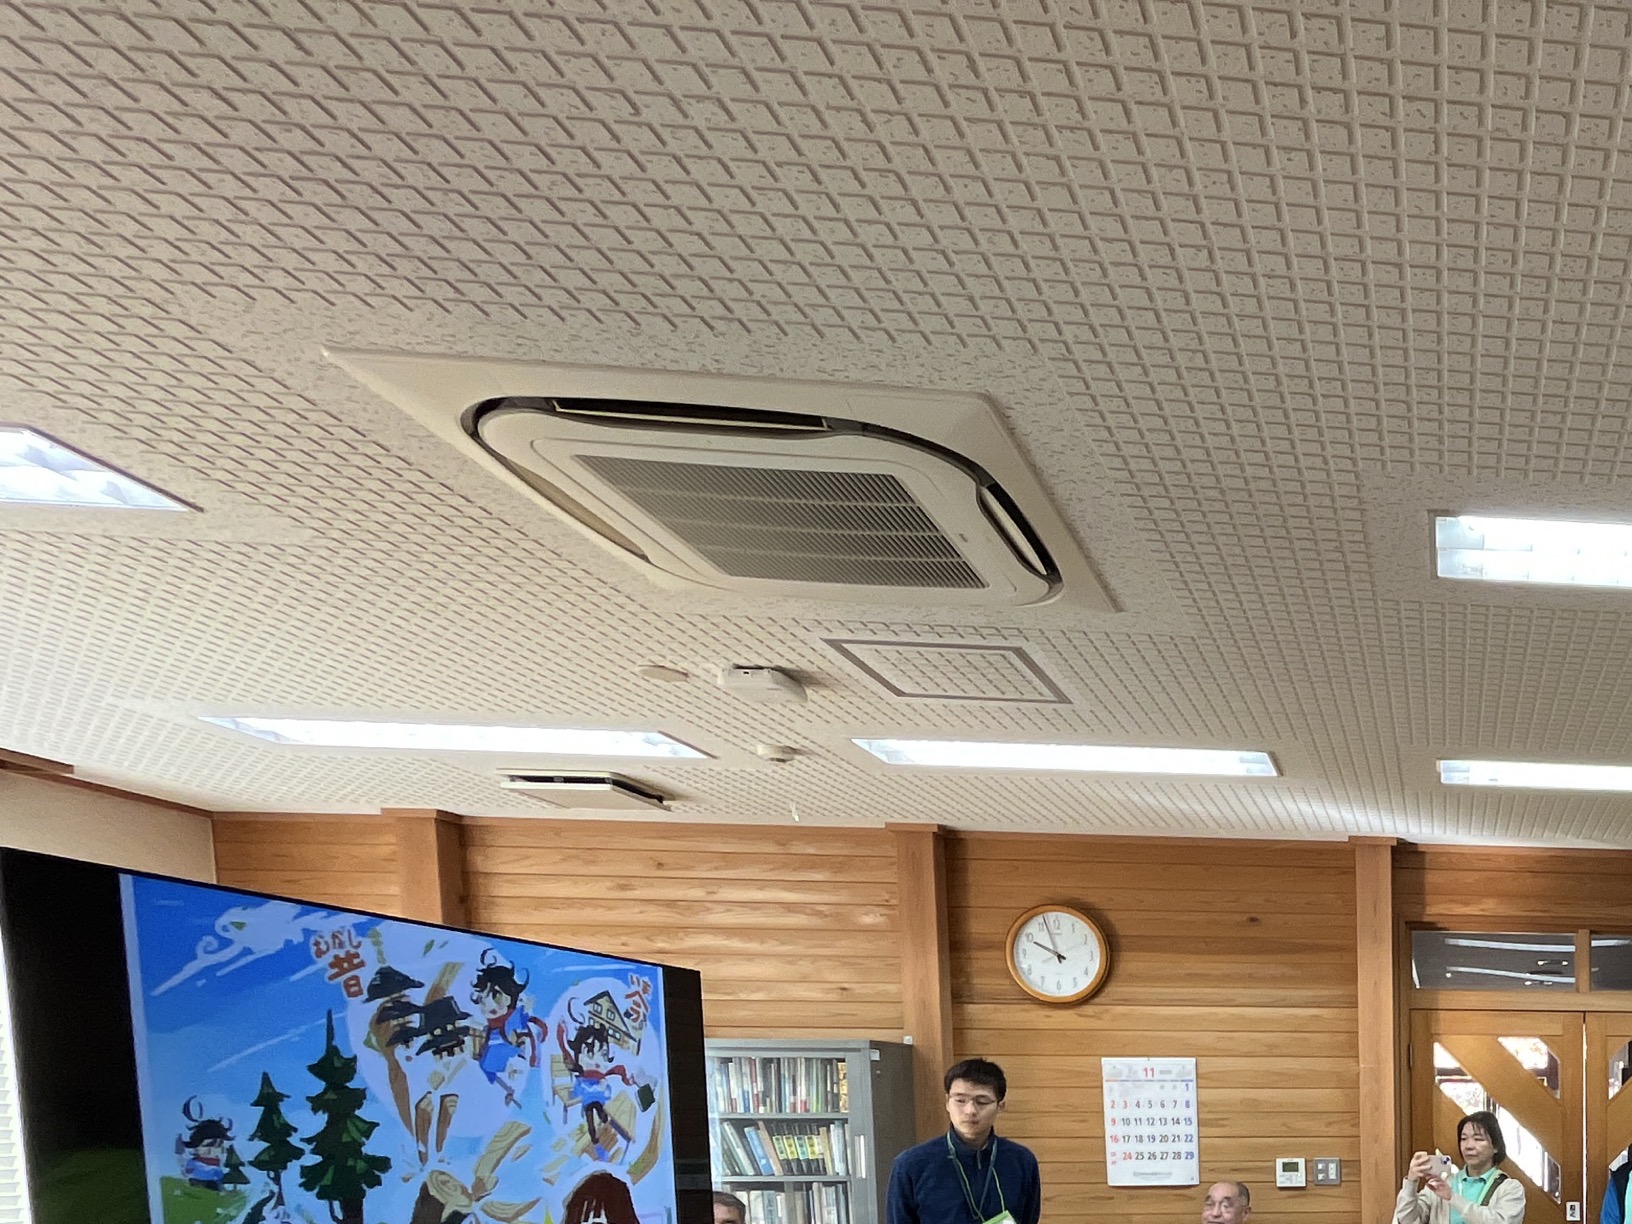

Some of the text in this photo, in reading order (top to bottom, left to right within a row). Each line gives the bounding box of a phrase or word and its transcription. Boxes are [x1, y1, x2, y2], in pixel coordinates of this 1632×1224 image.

[327, 949, 366, 998] 昔
[1143, 1067, 1155, 1078] 11
[1110, 1100, 1115, 1109] 2
[1123, 1100, 1128, 1109] 3
[1135, 1100, 1140, 1109] 4
[1148, 1100, 1152, 1109] 5
[1160, 1100, 1165, 1109] 6
[1173, 1100, 1177, 1109] 7
[1111, 1118, 1192, 1126] 9 10 11 12 13 14 15
[1110, 1135, 1193, 1143] 16 17 18 19 20 21 22
[1122, 1152, 1132, 1160] 24
[1135, 1152, 1144, 1160] 25
[1147, 1152, 1157, 1160] 26
[1160, 1152, 1169, 1160] 27
[1172, 1152, 1181, 1160] 28
[1184, 1152, 1194, 1160] 29
